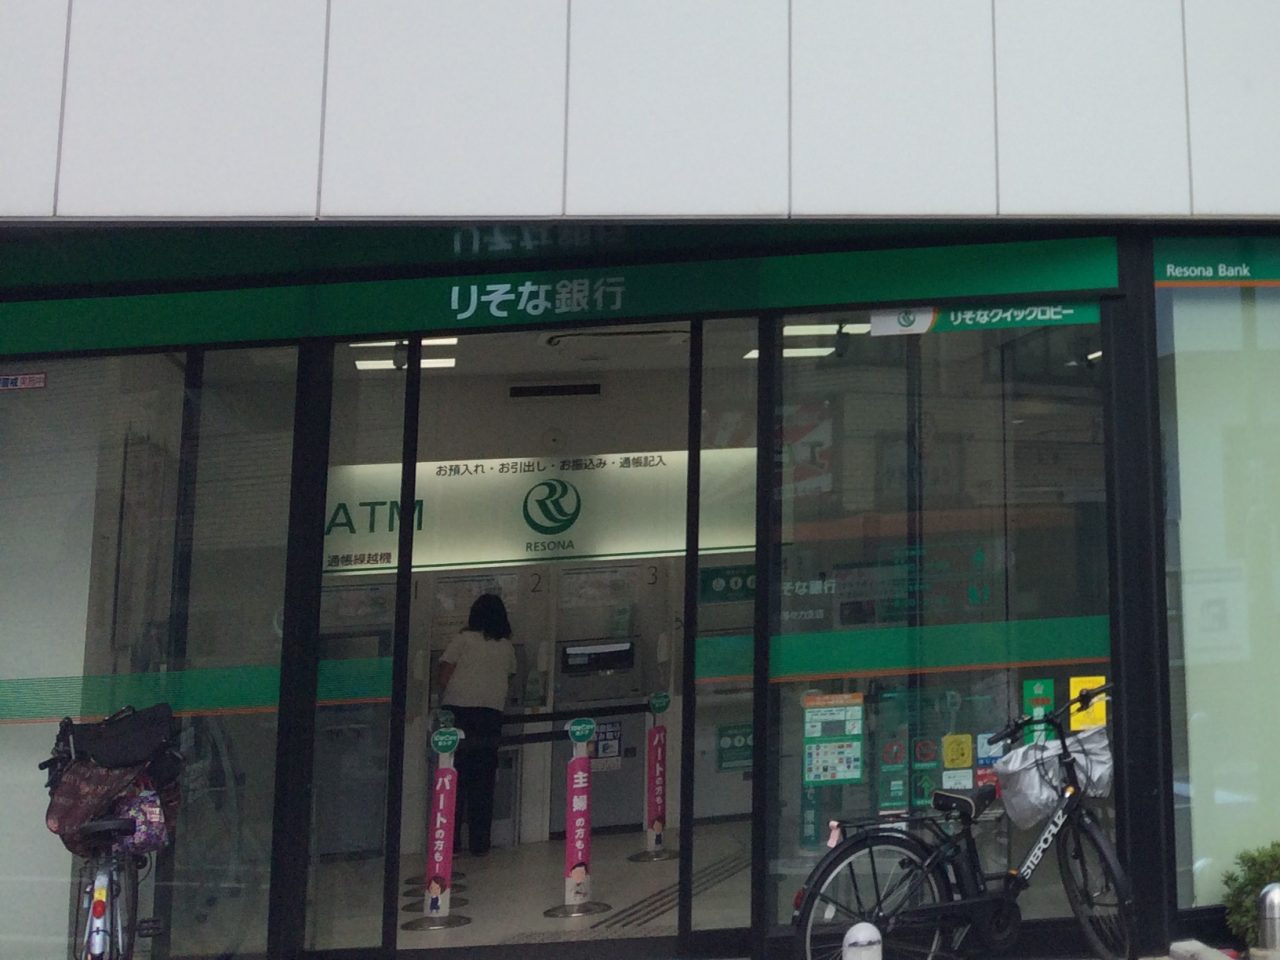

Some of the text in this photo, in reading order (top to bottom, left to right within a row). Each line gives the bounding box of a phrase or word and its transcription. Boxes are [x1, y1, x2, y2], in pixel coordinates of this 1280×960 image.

[1166, 263, 1251, 277] Resona Bank
[451, 276, 627, 320] りそな銀行
[950, 305, 1075, 326] りそなクイックロビー
[324, 500, 424, 536] ATM
[525, 540, 575, 553] RESONA
[530, 573, 542, 593] 2
[648, 566, 659, 586] 3
